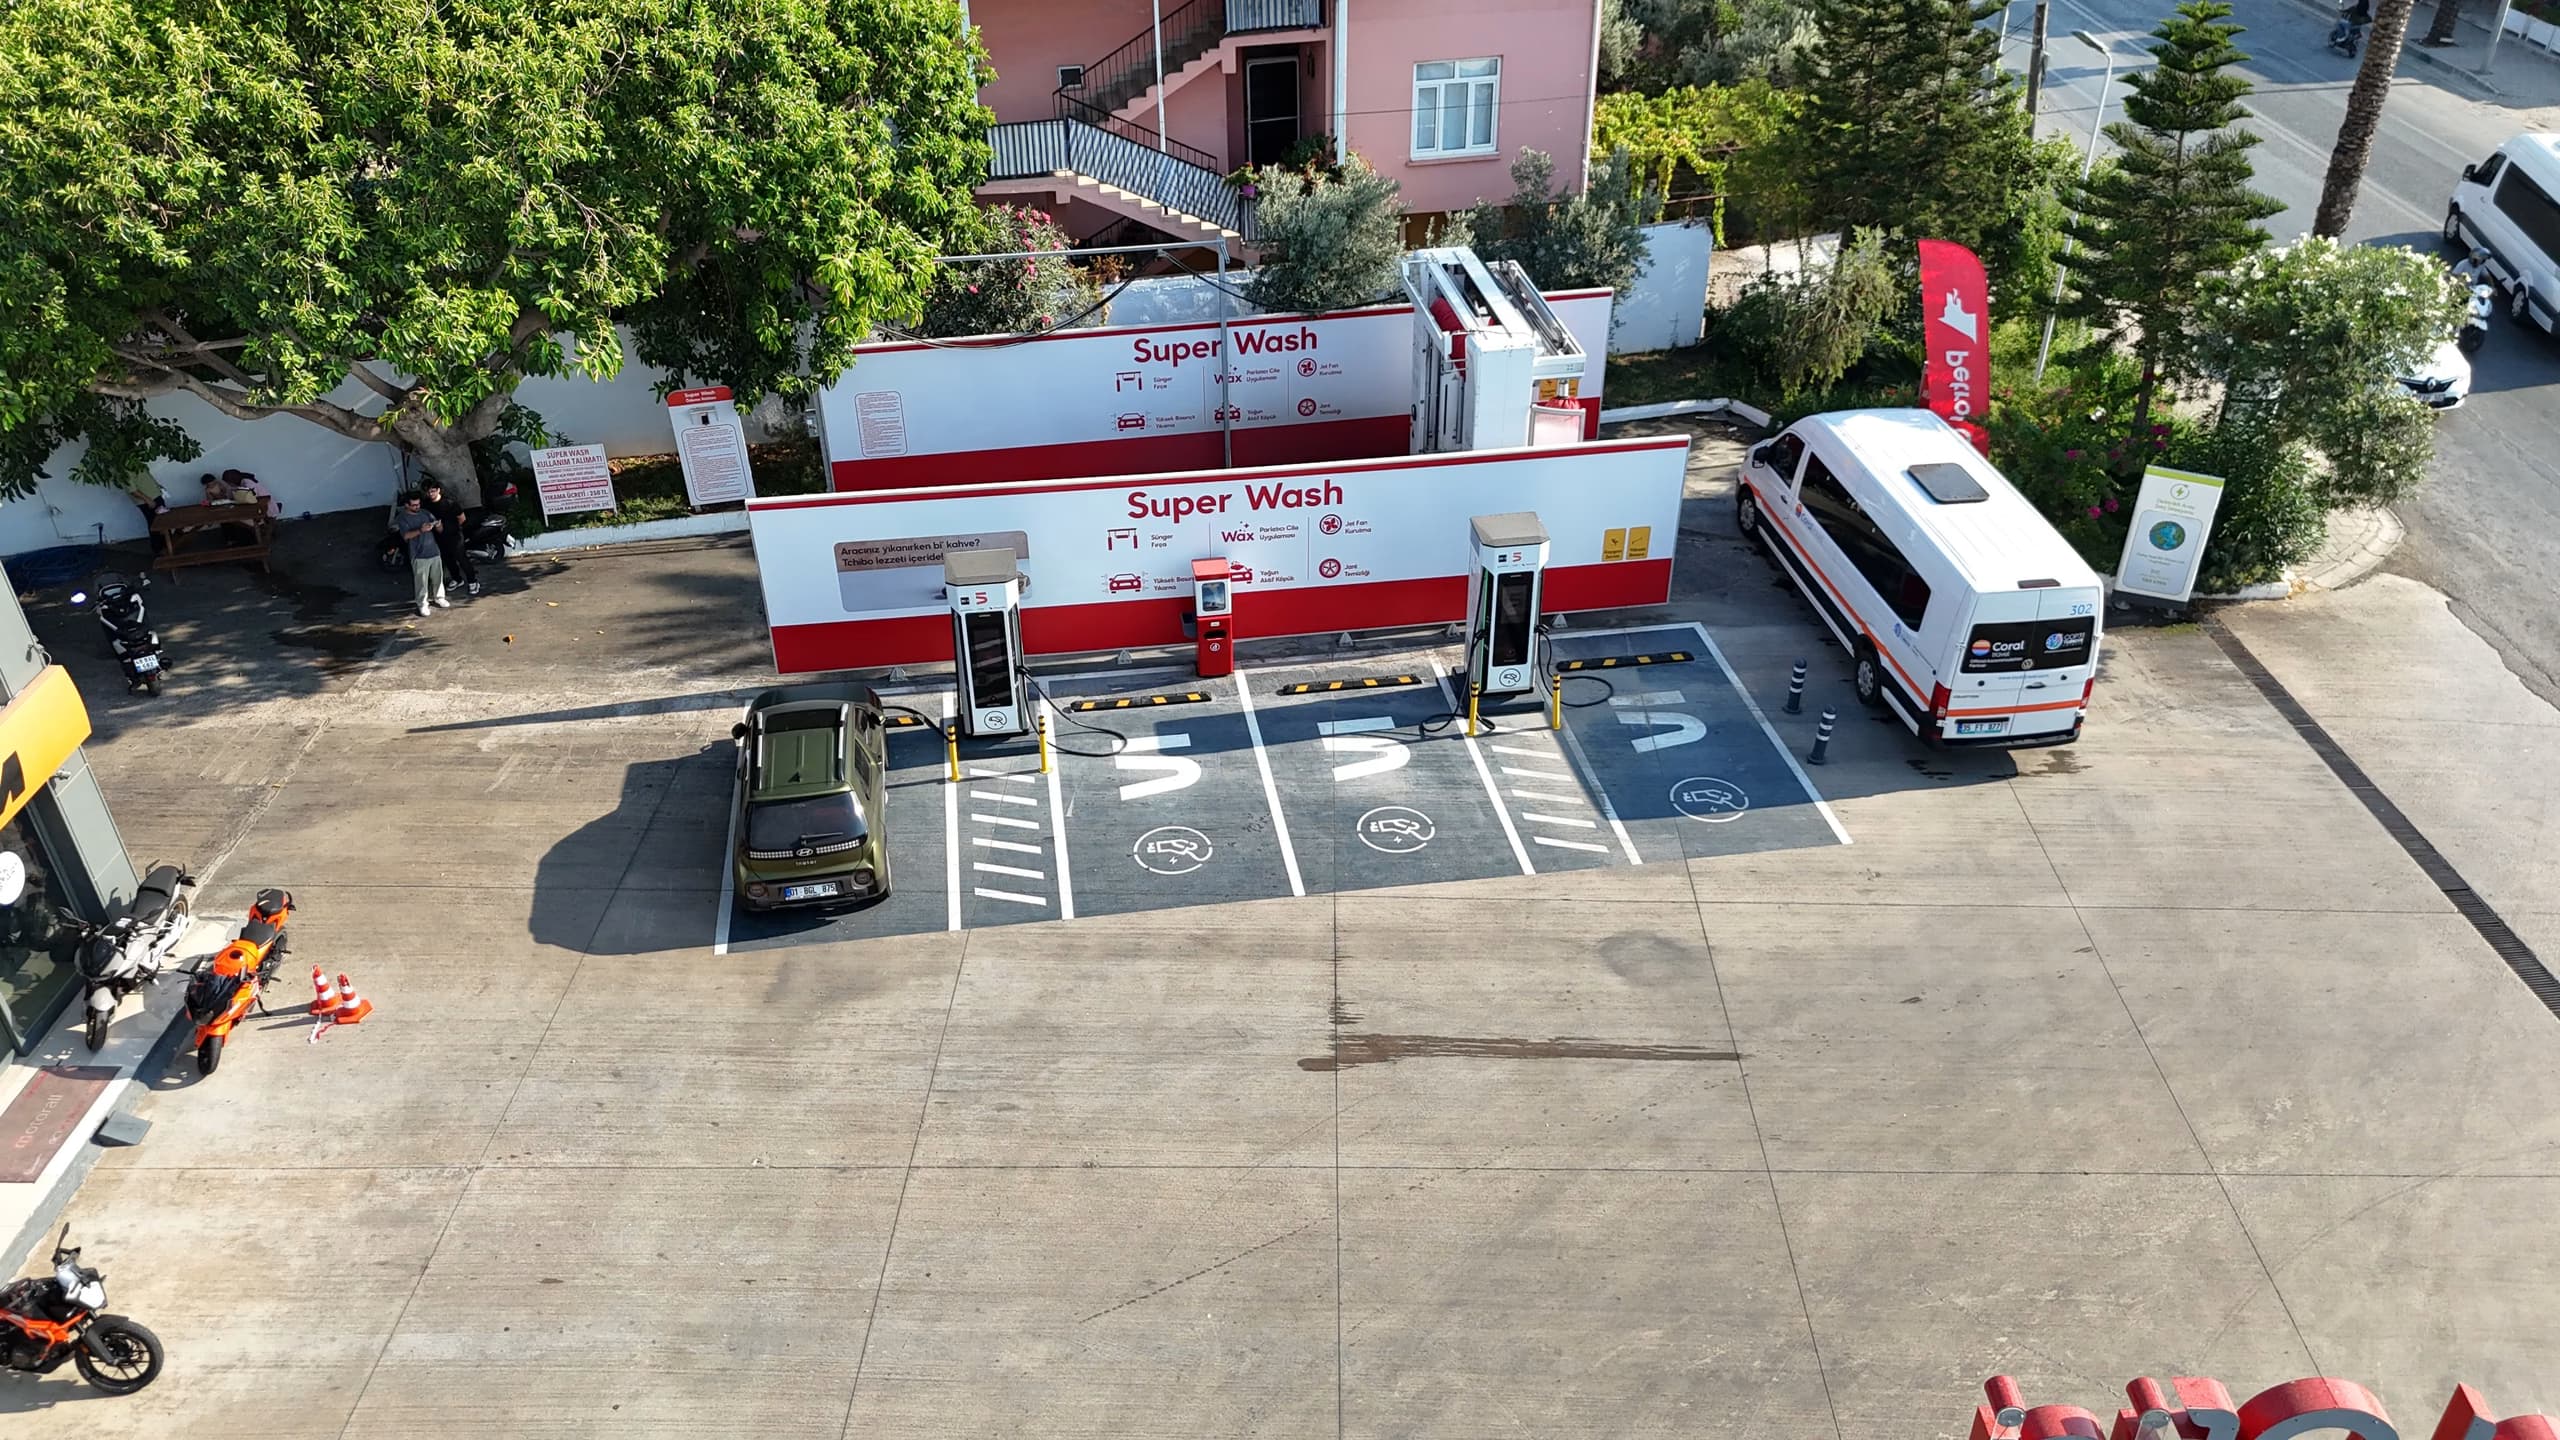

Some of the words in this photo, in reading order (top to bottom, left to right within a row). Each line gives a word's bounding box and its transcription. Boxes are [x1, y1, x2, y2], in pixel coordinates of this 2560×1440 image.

[1133, 338, 1222, 367] Super
[1233, 326, 1318, 355] Wash
[1213, 373, 1242, 384] Wax
[1127, 491, 1233, 524] Super
[1244, 479, 1343, 510] Wash
[1221, 530, 1254, 543] Wax
[841, 546, 880, 556] Aracınız
[881, 543, 931, 554] yıkanırken
[945, 538, 980, 549] kahve?
[842, 557, 874, 567] Tchibo
[875, 555, 907, 564] lezzeti
[2069, 603, 2093, 616] 302
[1992, 640, 2025, 652] Coral
[15, 1094, 64, 1148] motorall
